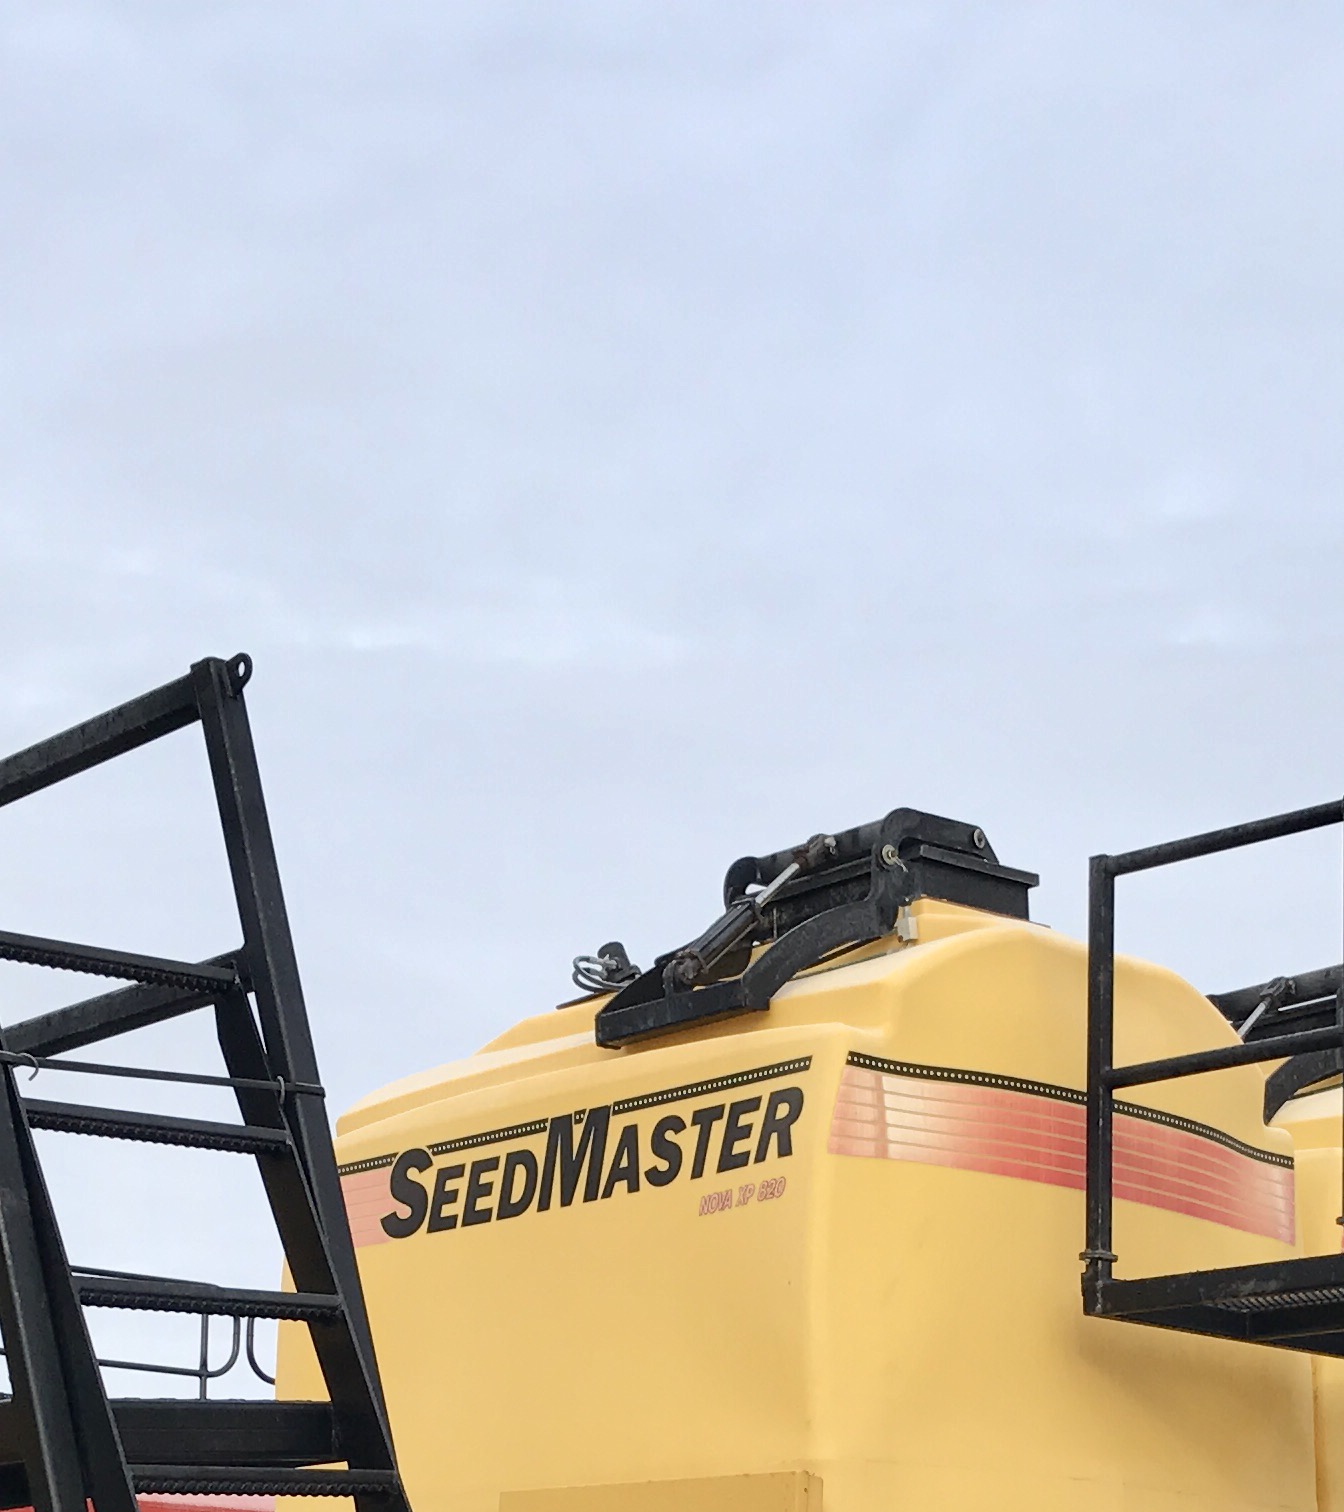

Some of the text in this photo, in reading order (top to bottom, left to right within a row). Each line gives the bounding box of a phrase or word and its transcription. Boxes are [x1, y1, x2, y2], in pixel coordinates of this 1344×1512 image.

[381, 1086, 804, 1239] SEEDMASTER
[699, 1176, 787, 1216] NOVA XP 820
